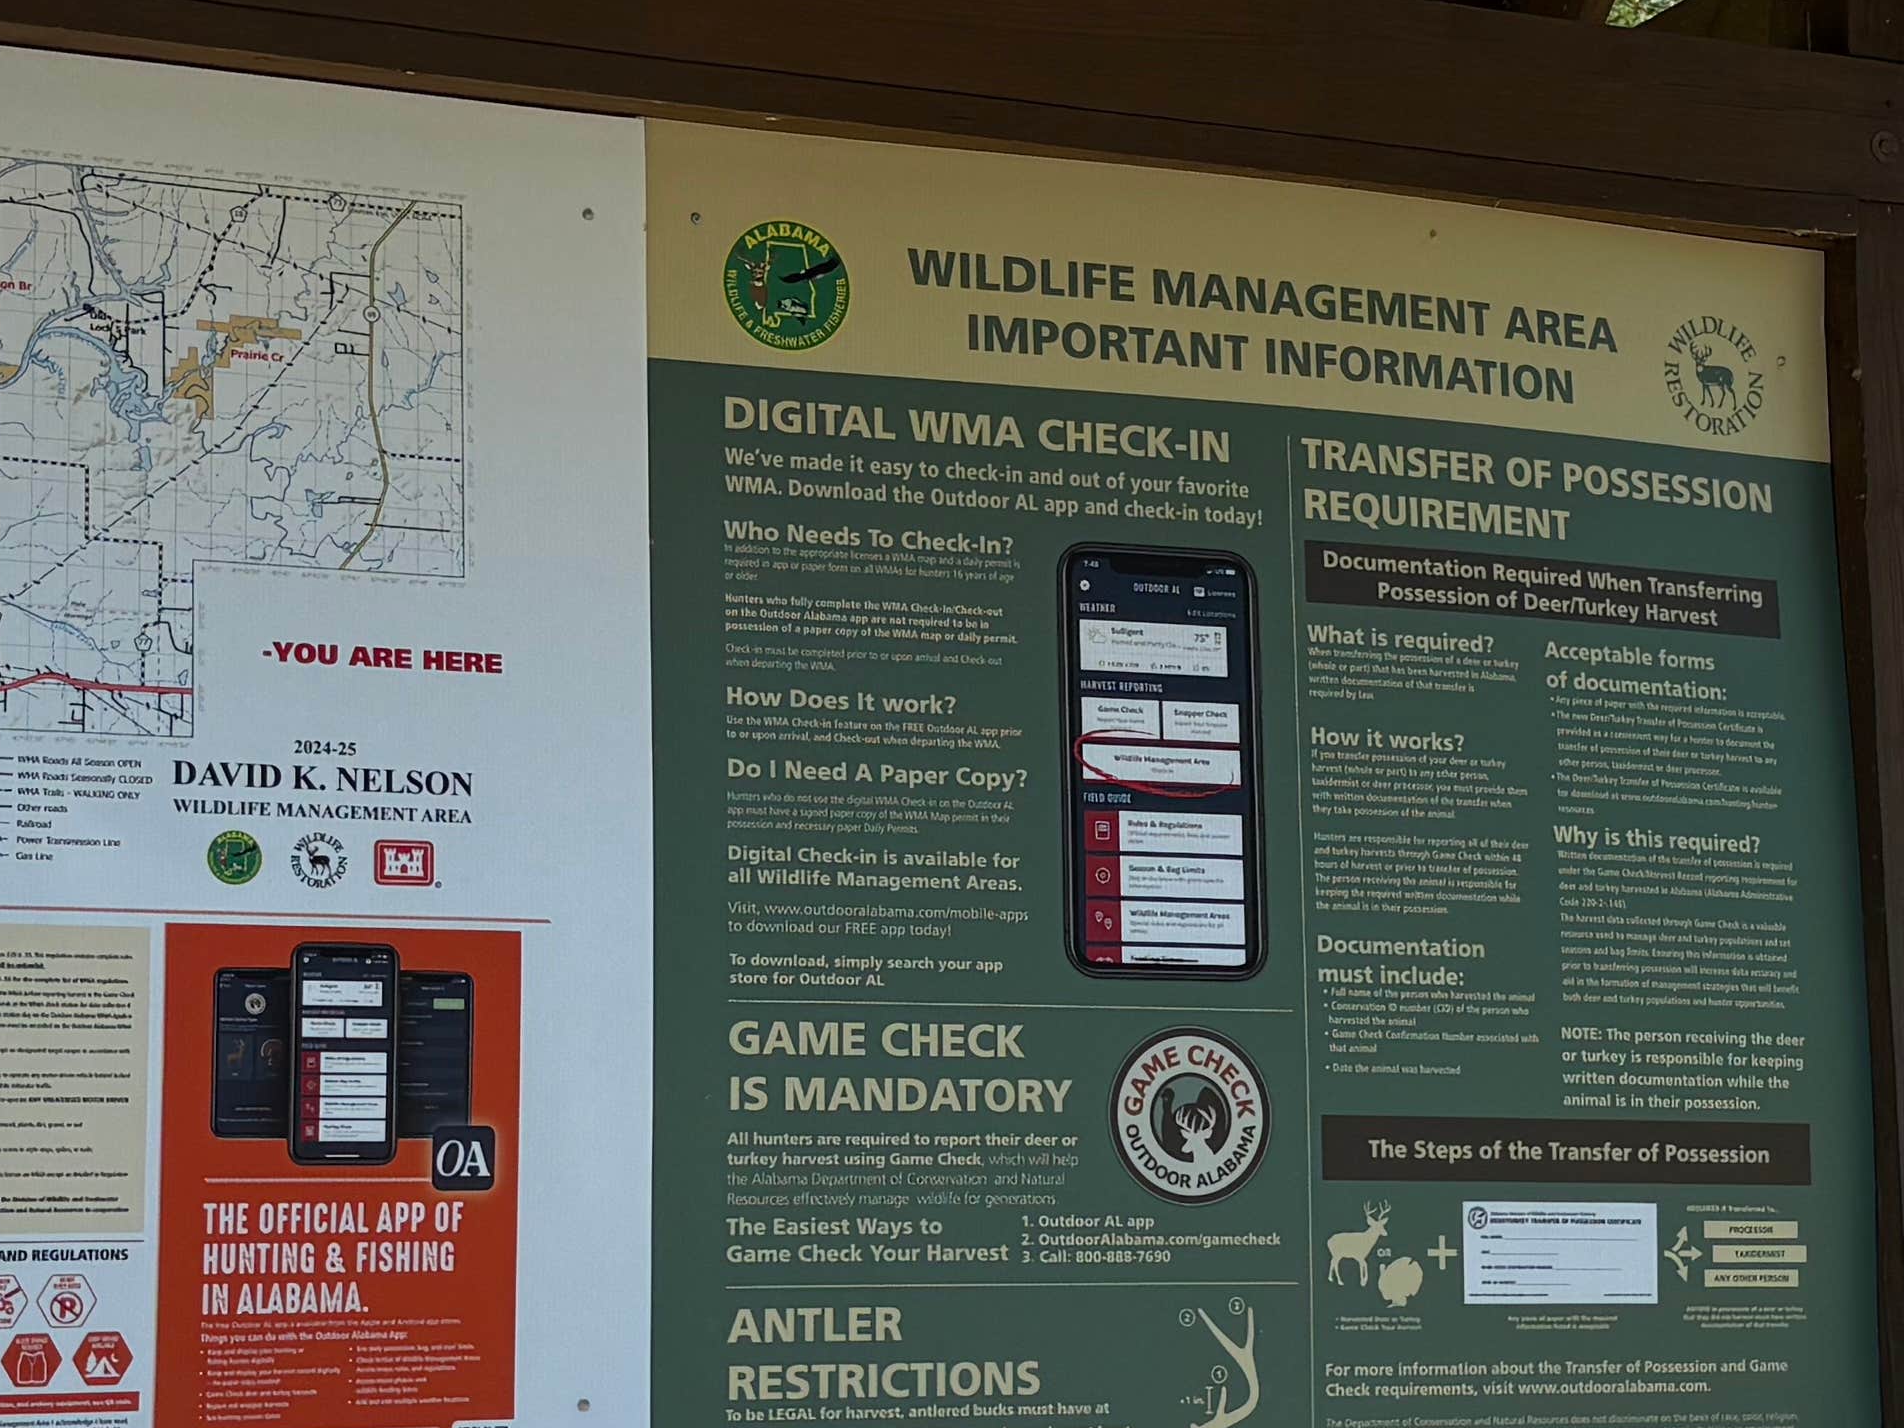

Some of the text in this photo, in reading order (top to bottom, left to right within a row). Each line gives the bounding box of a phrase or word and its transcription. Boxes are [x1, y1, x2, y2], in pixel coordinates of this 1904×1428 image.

[744, 223, 831, 257] ALABAMA
[18, 280, 33, 291] Br
[907, 247, 1618, 353] WILDLIFE MANAGEMENT AREA
[230, 349, 285, 363] Prairie Cr
[1668, 315, 1757, 363] WILDLIFE
[968, 313, 1573, 404] IMPORTANT INFORMATION
[1664, 360, 1764, 436] RESTORATION
[724, 396, 1229, 463] DIGITAL WMA CHECK-IN
[724, 446, 1249, 498] We've made it easy to check-in and out of your favorite
[1300, 437, 1772, 513] TRANSFER OF POSSESSION
[725, 474, 1262, 529] WMA. Download the Outdoor AL app and check-in today!
[1304, 488, 1570, 540] REQUIREMENT
[723, 519, 1013, 555] Who Needs To Check-In?
[1323, 549, 1762, 608] Documentation Required When Transferring
[1378, 581, 1718, 626] Possession of Deer/Turkey Harvest
[1307, 624, 1494, 654] What is required?
[1544, 641, 1715, 670] Acceptable forms
[348, 646, 412, 669] ARE
[423, 650, 502, 674] HERE
[726, 686, 956, 714] How Does It work?
[1546, 670, 1726, 700] of documentation:
[294, 739, 356, 756] 2024-25
[1311, 726, 1464, 752] How it works?
[173, 760, 472, 796] DAVID K. NELSON
[727, 758, 1027, 792] Do I Need A Paper Copy?
[173, 798, 471, 824] WILDLIFE MANAGEMENT AREA
[293, 831, 345, 854] WILDLIFE
[1553, 824, 1760, 855] Why is this required?
[290, 855, 348, 889] RESTORATION
[1317, 934, 1485, 958] Documentation
[1318, 964, 1463, 986] must include:
[729, 1020, 1024, 1058] GAME CHECK
[730, 1076, 1072, 1112] IS MANDATORY
[1124, 1044, 1256, 1119] GAME CHECK
[436, 1139, 491, 1177] OA
[1125, 1123, 1257, 1189] OUTDOOR ALABAMA
[1368, 1138, 1769, 1164] The Steps of the Transfer of Possession
[203, 1201, 464, 1234] THE OFFICIAL APP OF
[1022, 1214, 1154, 1230] 1. Outdoor AL app
[31, 1248, 128, 1261] REGULATIONS
[1021, 1232, 1280, 1248] 2. OutdoorAlabama.com/gamecheck
[1022, 1249, 1171, 1263] 3. Call: 800-888-7690
[203, 1240, 454, 1275] HUNTING & FISHING
[202, 1281, 368, 1315] IN ALABAMA.
[727, 1306, 902, 1343] ANTLER
[728, 1360, 1040, 1400] RESTRICTIONS
